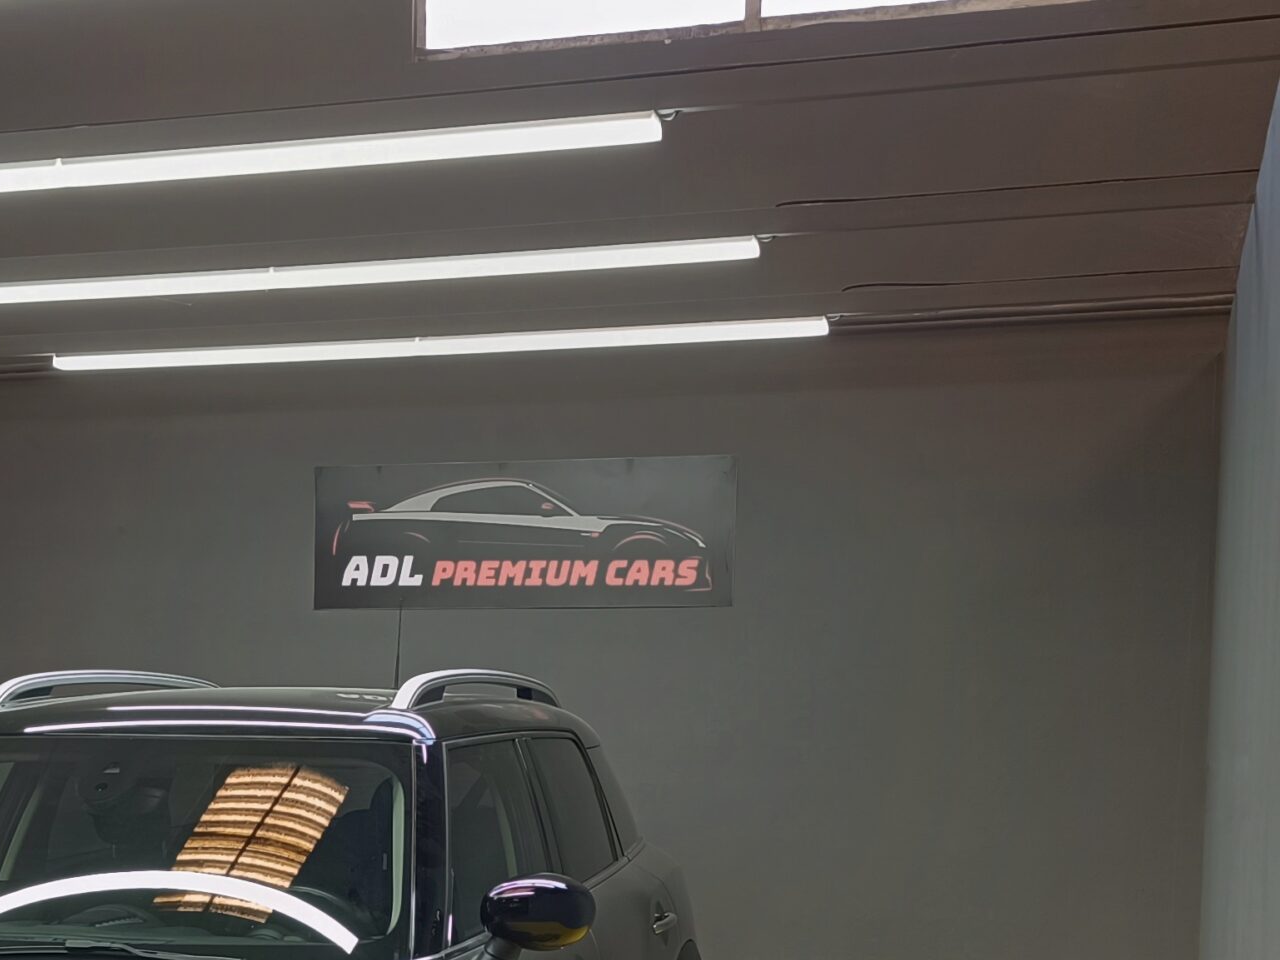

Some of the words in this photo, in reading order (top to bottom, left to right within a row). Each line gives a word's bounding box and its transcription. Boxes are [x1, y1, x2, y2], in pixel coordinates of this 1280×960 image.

[341, 555, 423, 587] ADL
[431, 559, 599, 587] PREMIUM
[605, 559, 700, 587] CARS
